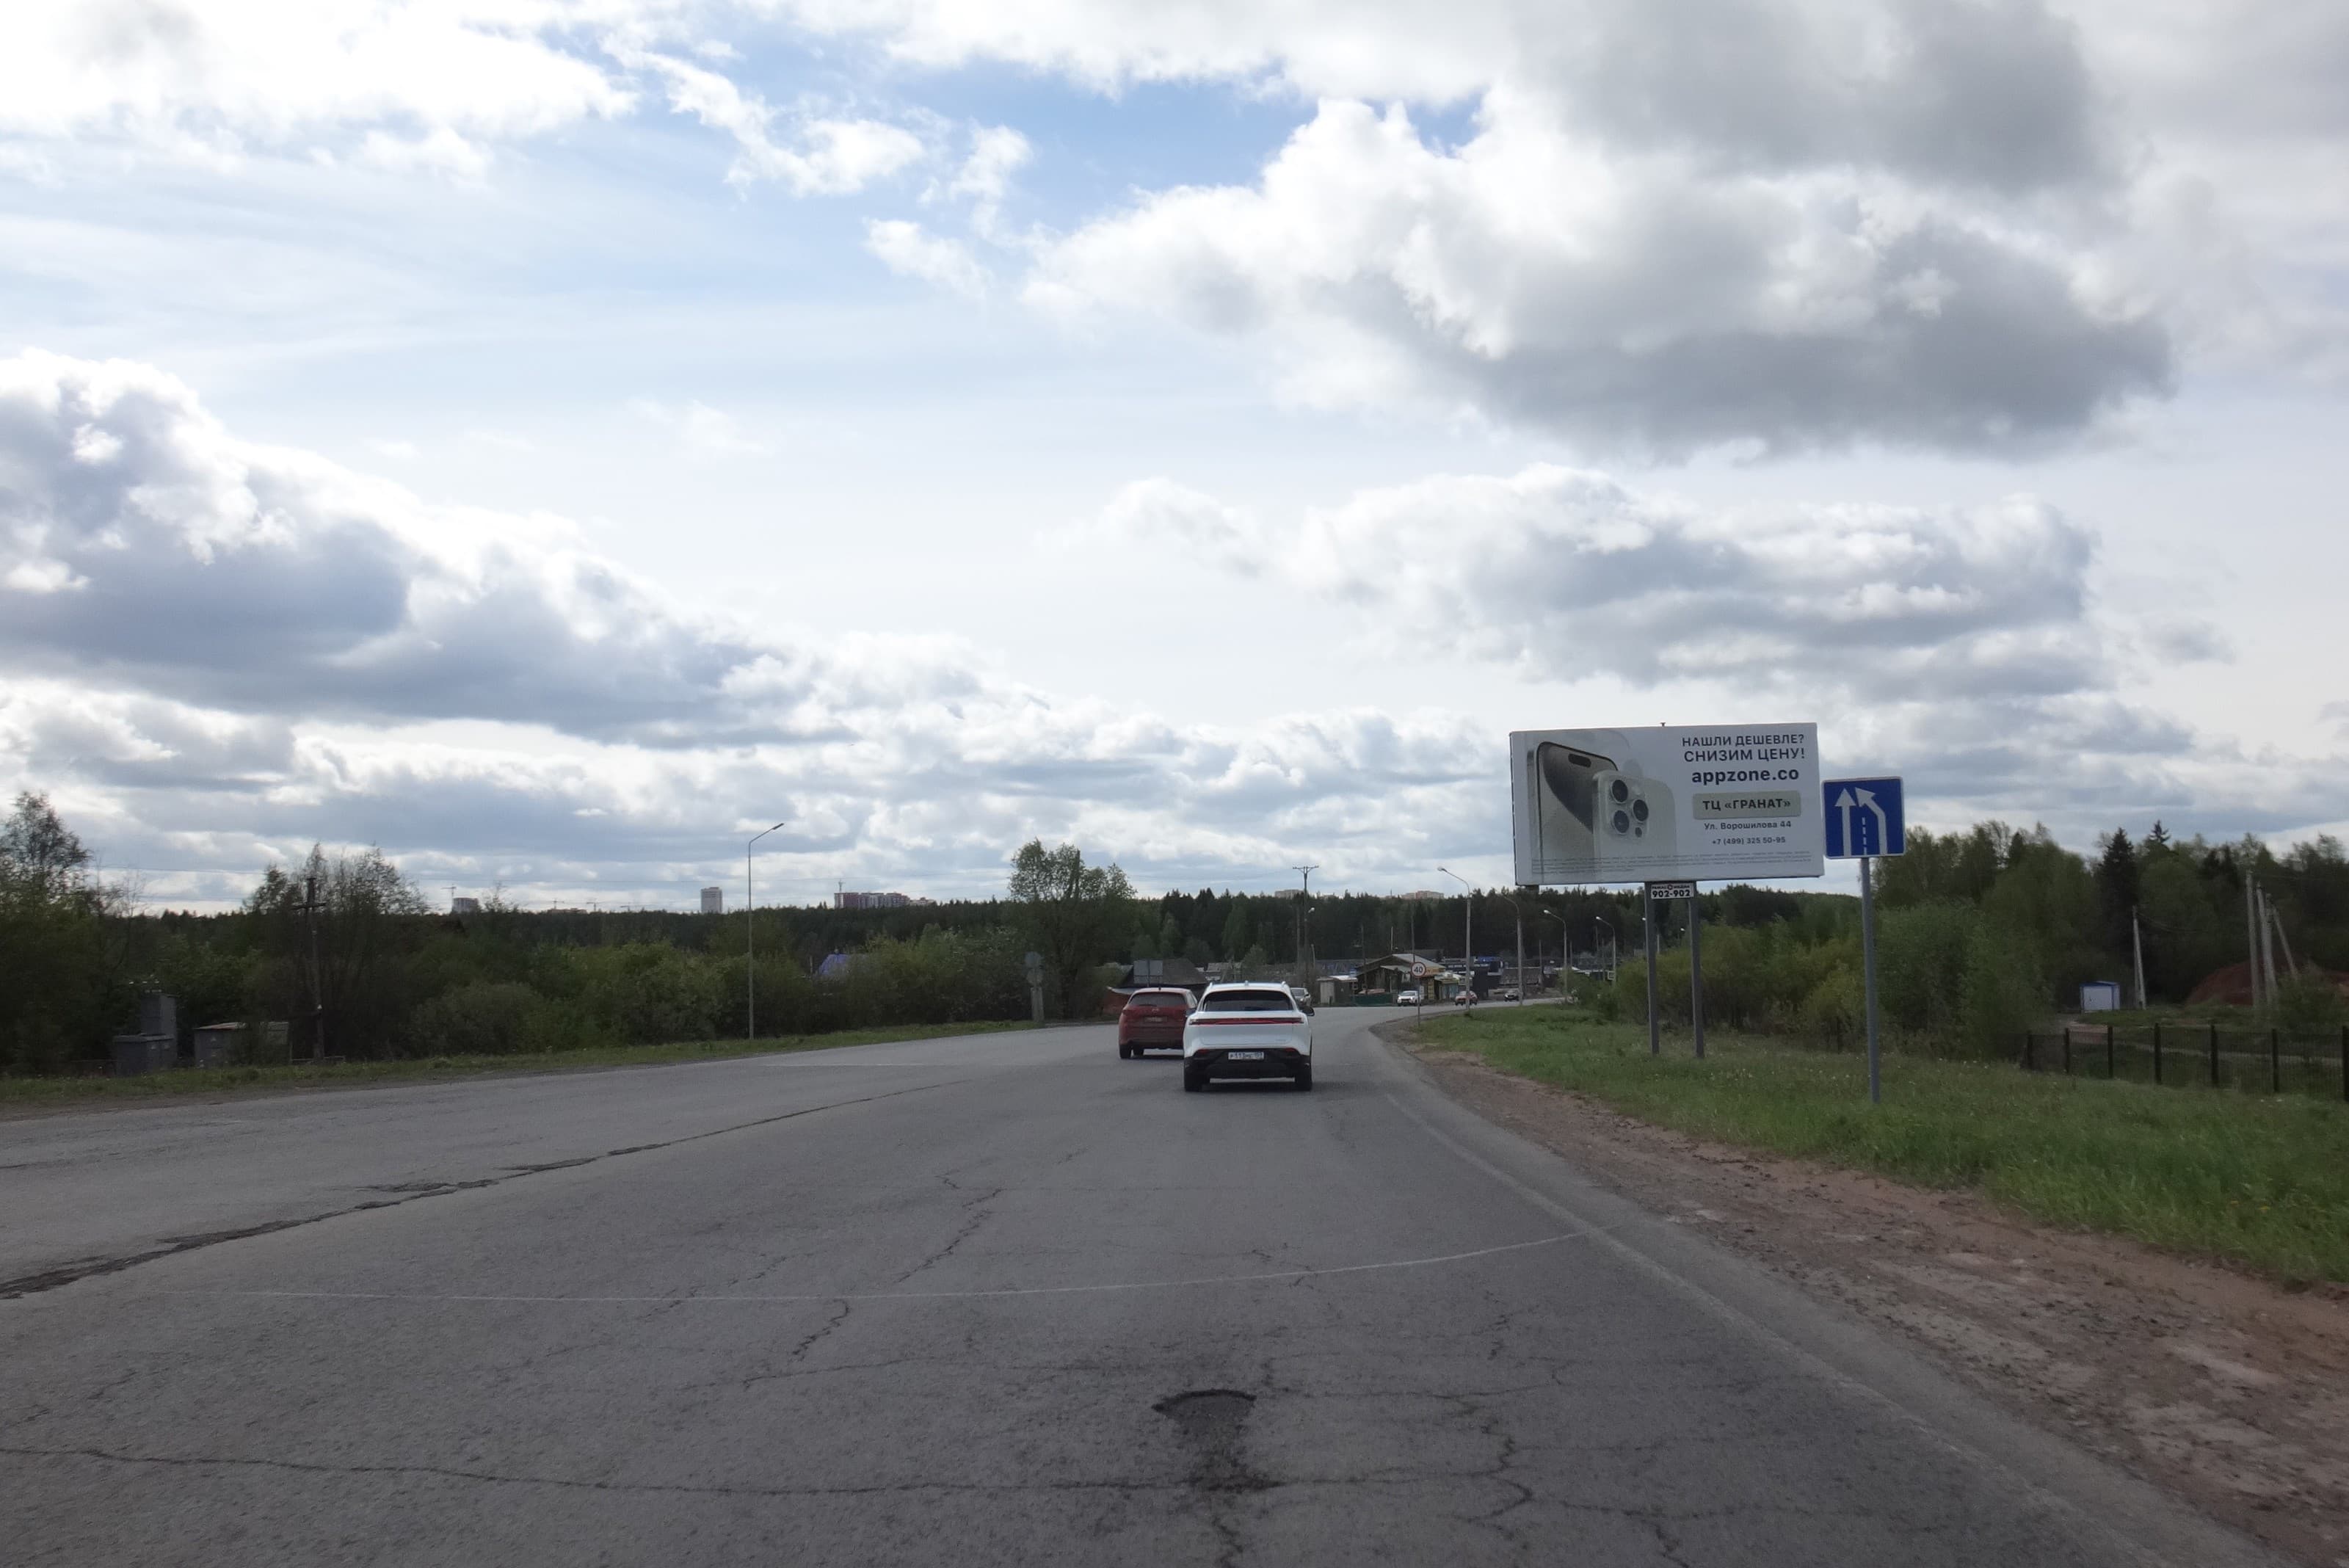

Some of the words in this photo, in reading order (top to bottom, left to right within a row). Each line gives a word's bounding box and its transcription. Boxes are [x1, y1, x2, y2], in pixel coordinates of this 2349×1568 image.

[1682, 736, 1731, 747] НАШЛИ
[1735, 734, 1804, 746] ДЕШЕВЛЕ?
[1684, 749, 1753, 762] СНИЗИМ
[1757, 748, 1805, 761] ЦЕНУ!
[1692, 769, 1799, 785] appzone.co
[1702, 800, 1721, 811] ТЦ
[1724, 798, 1791, 809] «ГРАНАТ»
[1721, 821, 1777, 830] Ворошилова
[1652, 889, 1691, 898] 902-902
